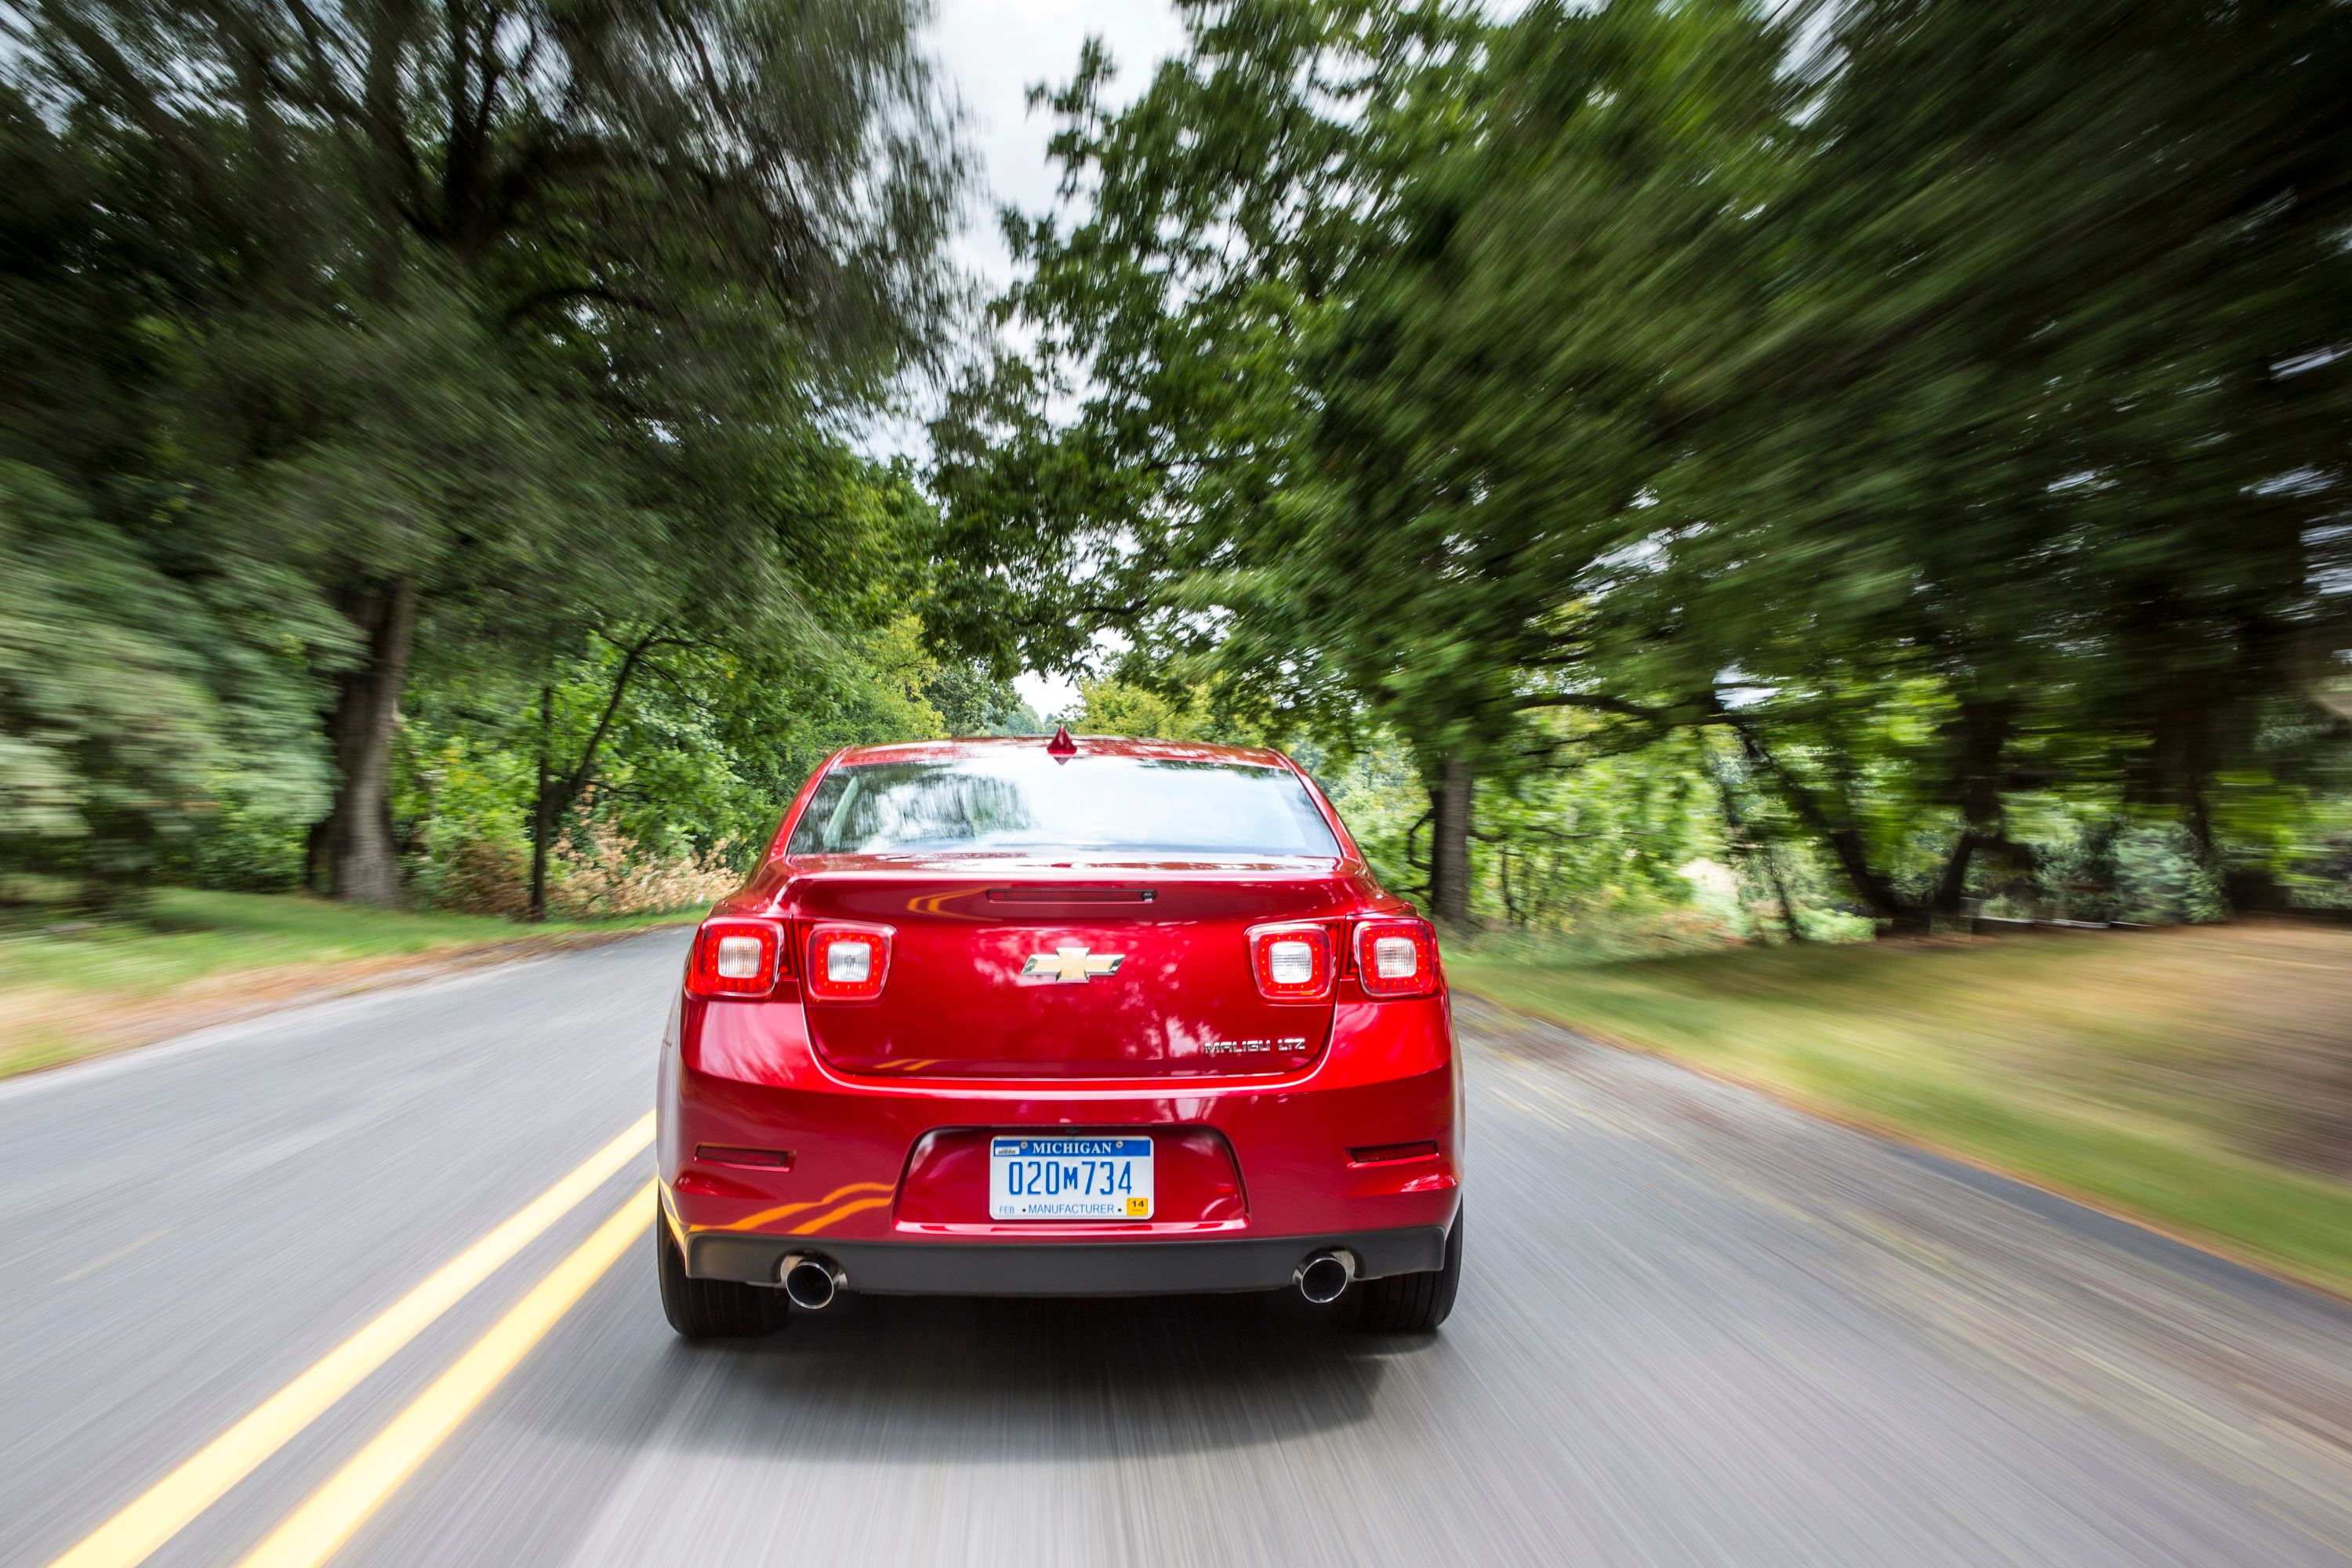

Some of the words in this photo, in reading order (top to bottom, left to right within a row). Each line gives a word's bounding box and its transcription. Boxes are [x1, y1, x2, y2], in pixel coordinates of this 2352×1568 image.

[1204, 1039, 1270, 1054] MALIBU
[1278, 1038, 1305, 1051] LTZ
[1032, 1142, 1112, 1154] MICHIGAN
[1008, 1161, 1132, 1195] 020M734
[999, 1206, 1015, 1214] FEB
[1029, 1204, 1114, 1214] MANUFACTURER
[1131, 1200, 1145, 1208] 14
